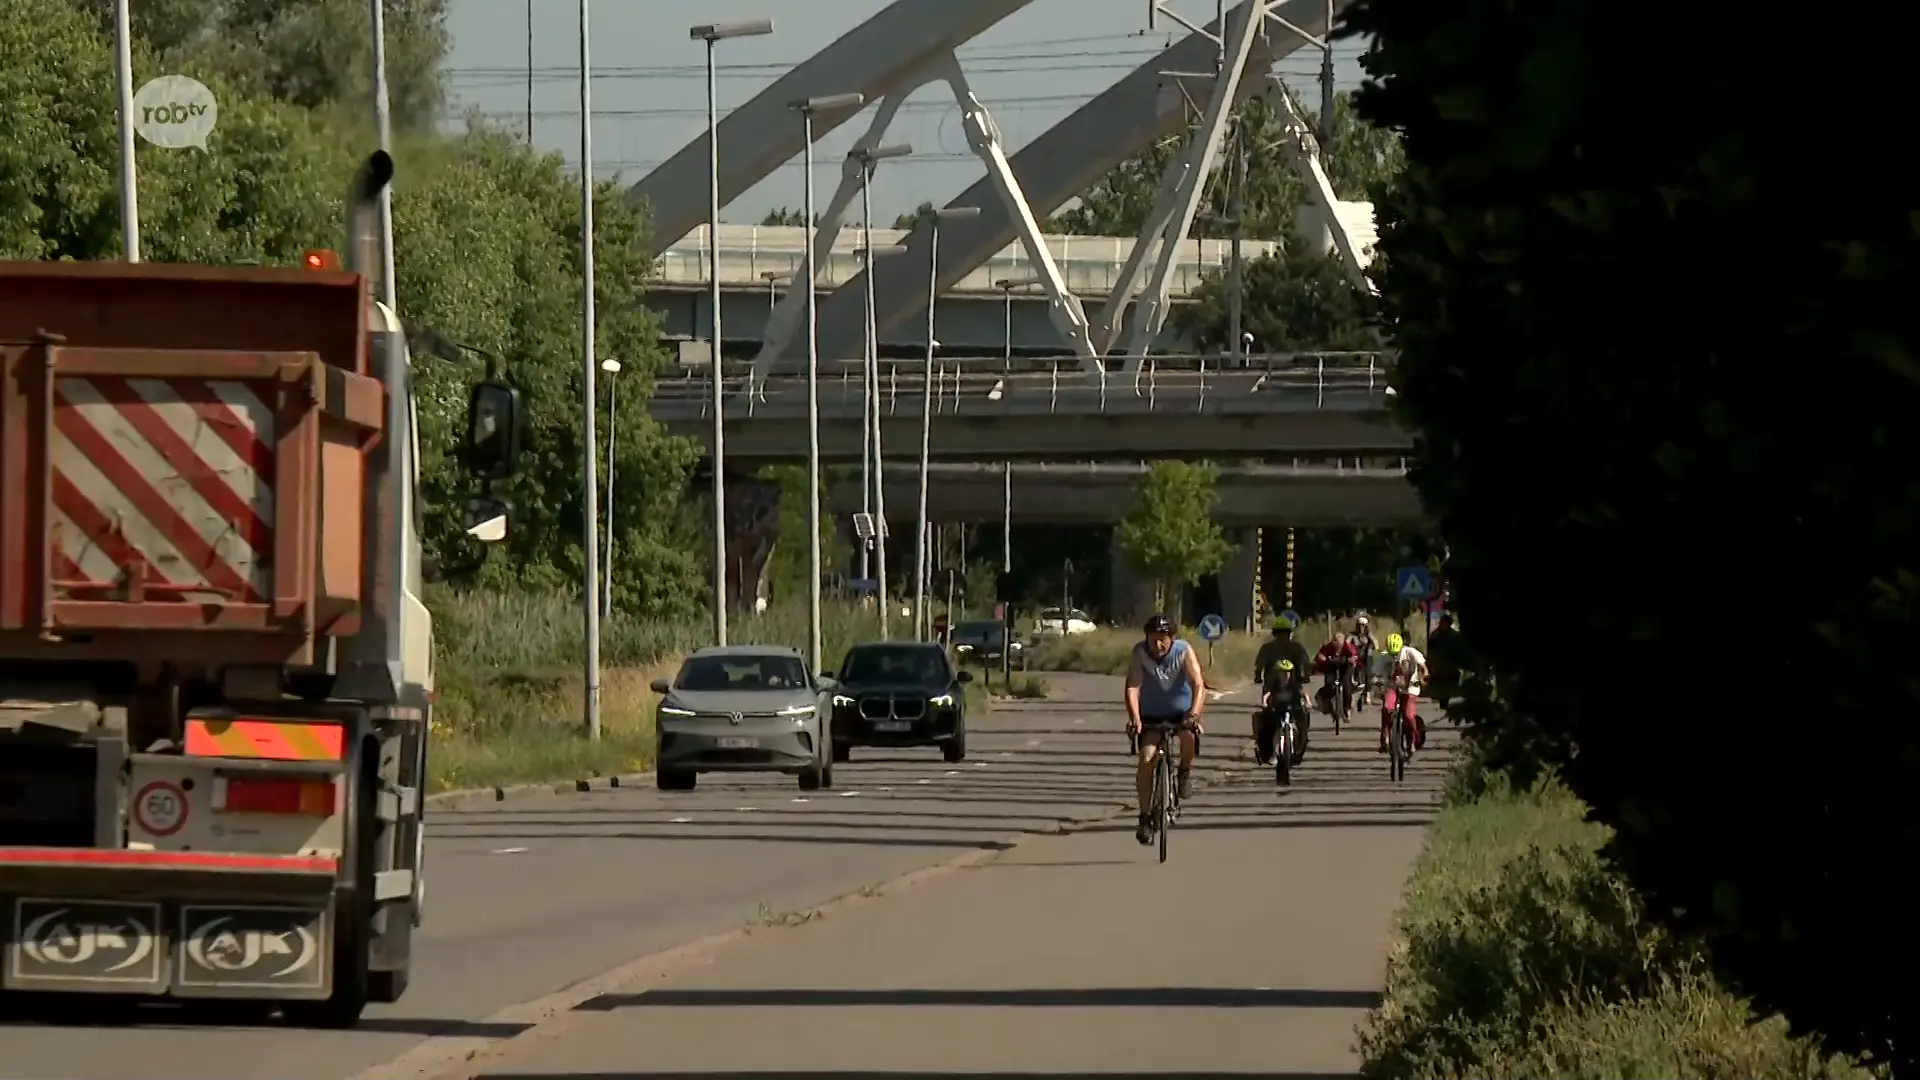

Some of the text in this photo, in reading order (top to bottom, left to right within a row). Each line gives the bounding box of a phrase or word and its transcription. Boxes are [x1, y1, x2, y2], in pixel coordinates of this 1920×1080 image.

[147, 795, 176, 816] 60
[40, 923, 128, 964] AJK
[206, 931, 293, 970] AJK
